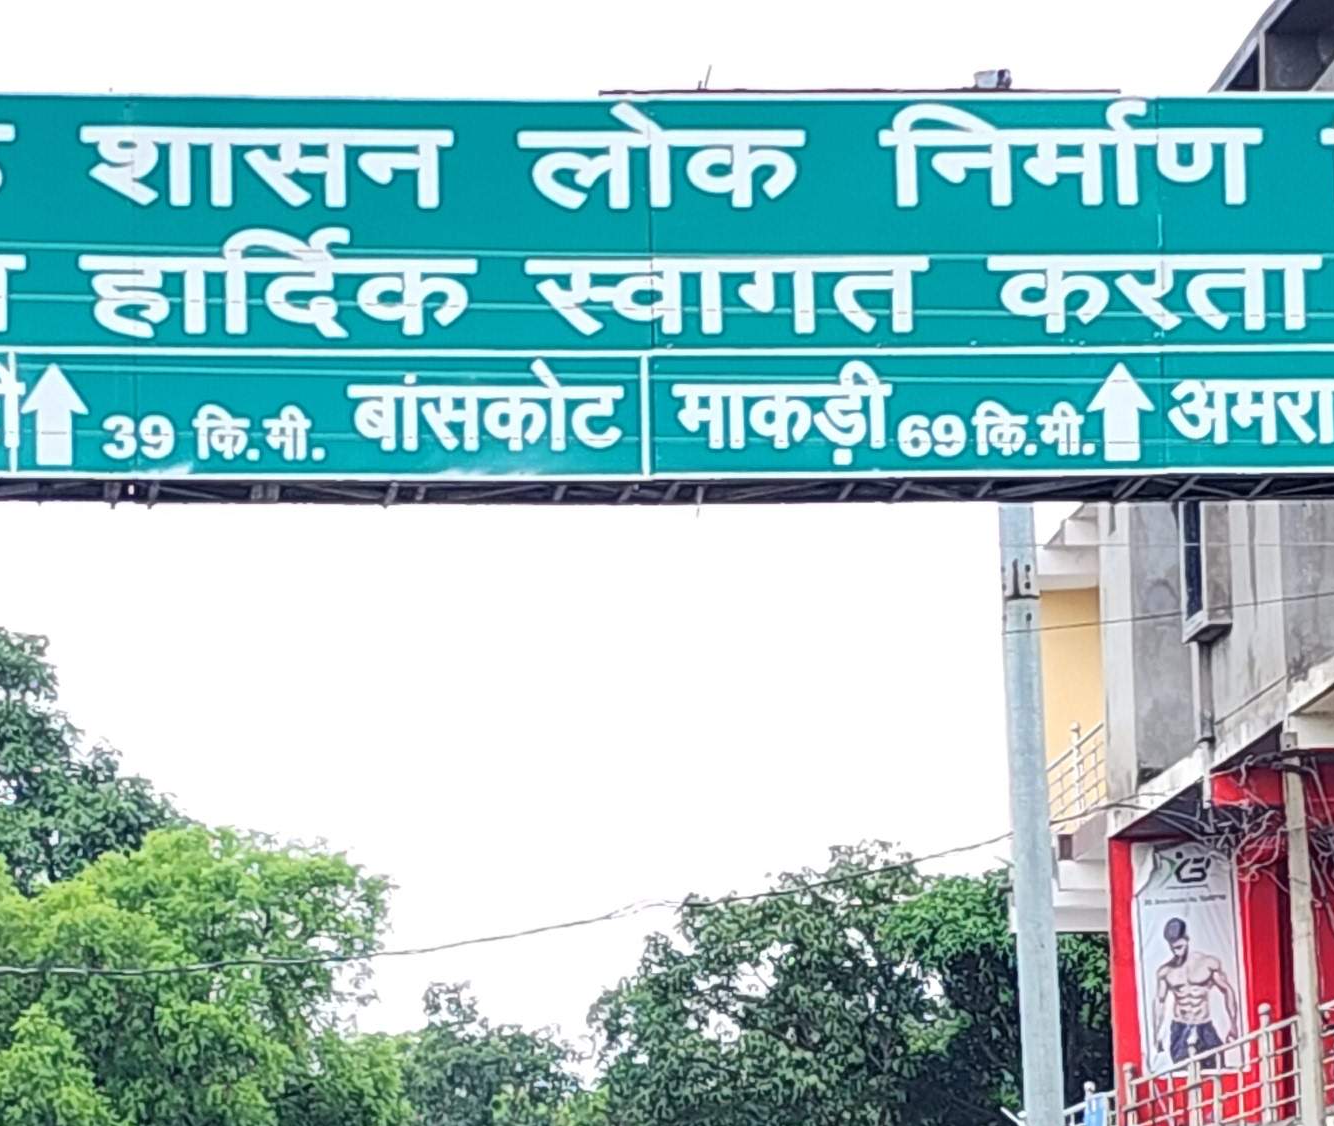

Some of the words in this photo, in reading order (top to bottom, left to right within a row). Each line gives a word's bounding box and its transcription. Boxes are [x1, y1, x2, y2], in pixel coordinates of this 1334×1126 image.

[79, 125, 454, 209] शासन
[517, 101, 807, 209] लोक
[877, 99, 1264, 206] निर्माण
[78, 226, 478, 338] हार्दिक
[524, 254, 930, 335] स्वागत
[986, 253, 1324, 334] करता
[102, 414, 175, 460] 39
[192, 404, 326, 460] कि.मी.
[346, 358, 625, 452] बांसकोट
[671, 359, 893, 466] माकड़ी
